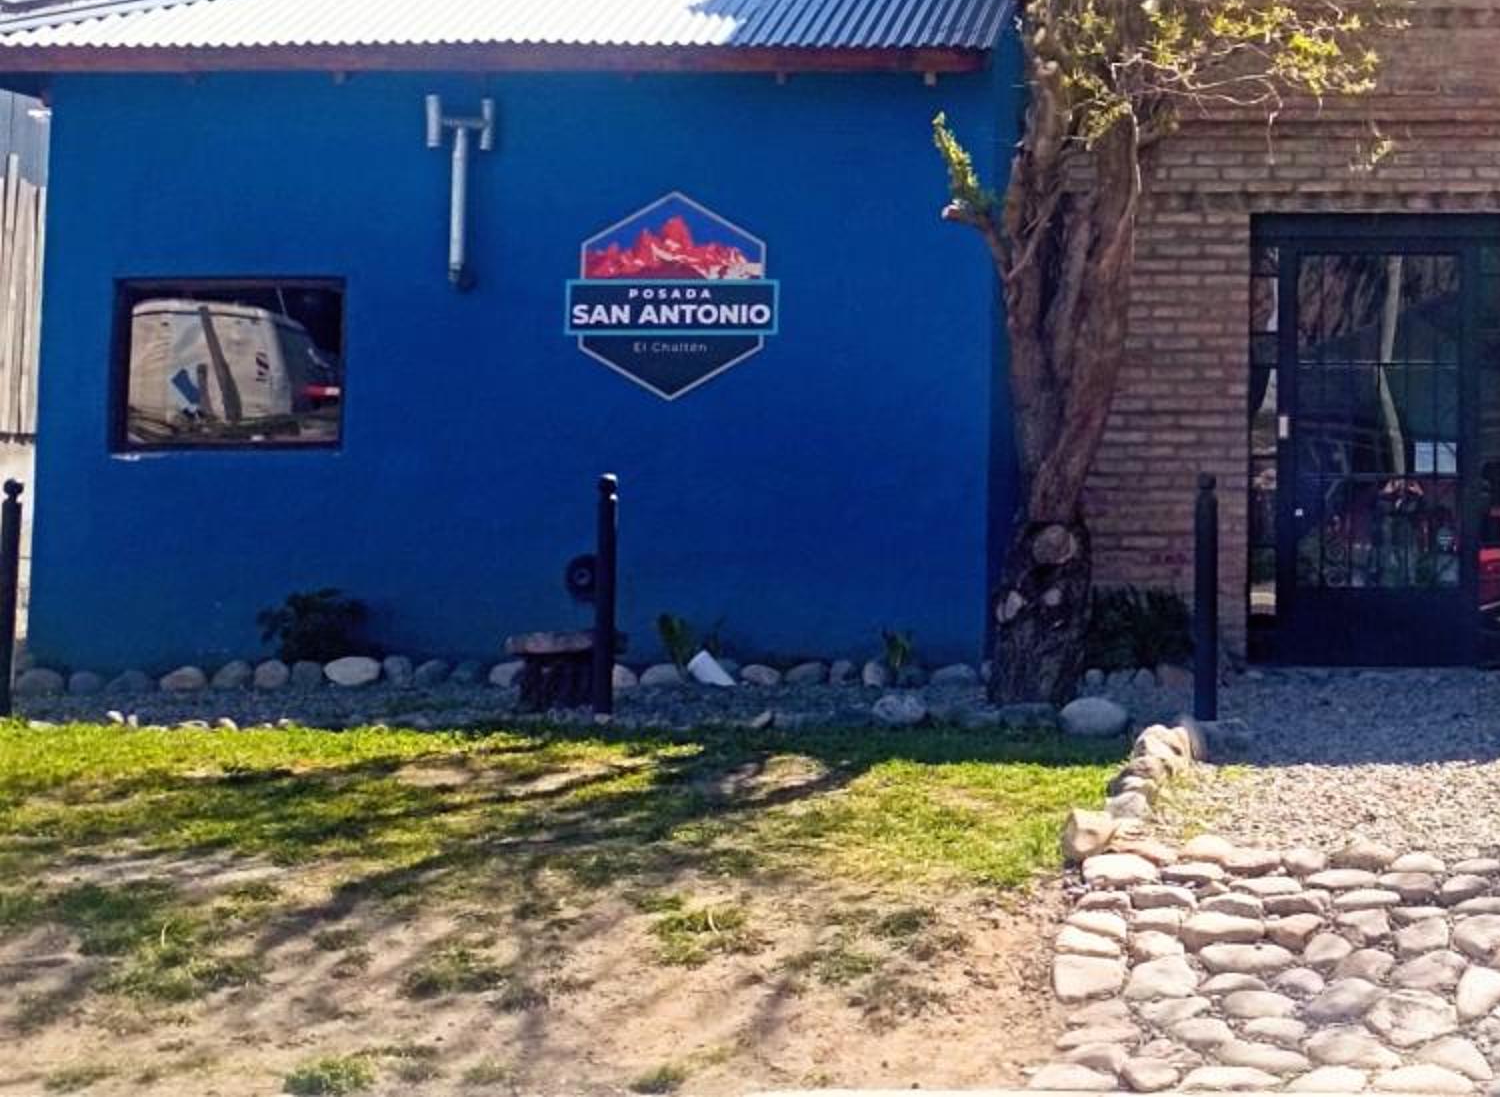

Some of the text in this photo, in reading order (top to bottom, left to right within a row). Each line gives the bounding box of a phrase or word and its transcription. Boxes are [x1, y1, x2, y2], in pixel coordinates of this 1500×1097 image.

[628, 288, 711, 299] POSADA
[572, 304, 771, 324] SAN ANTONIO
[632, 341, 647, 353] El
